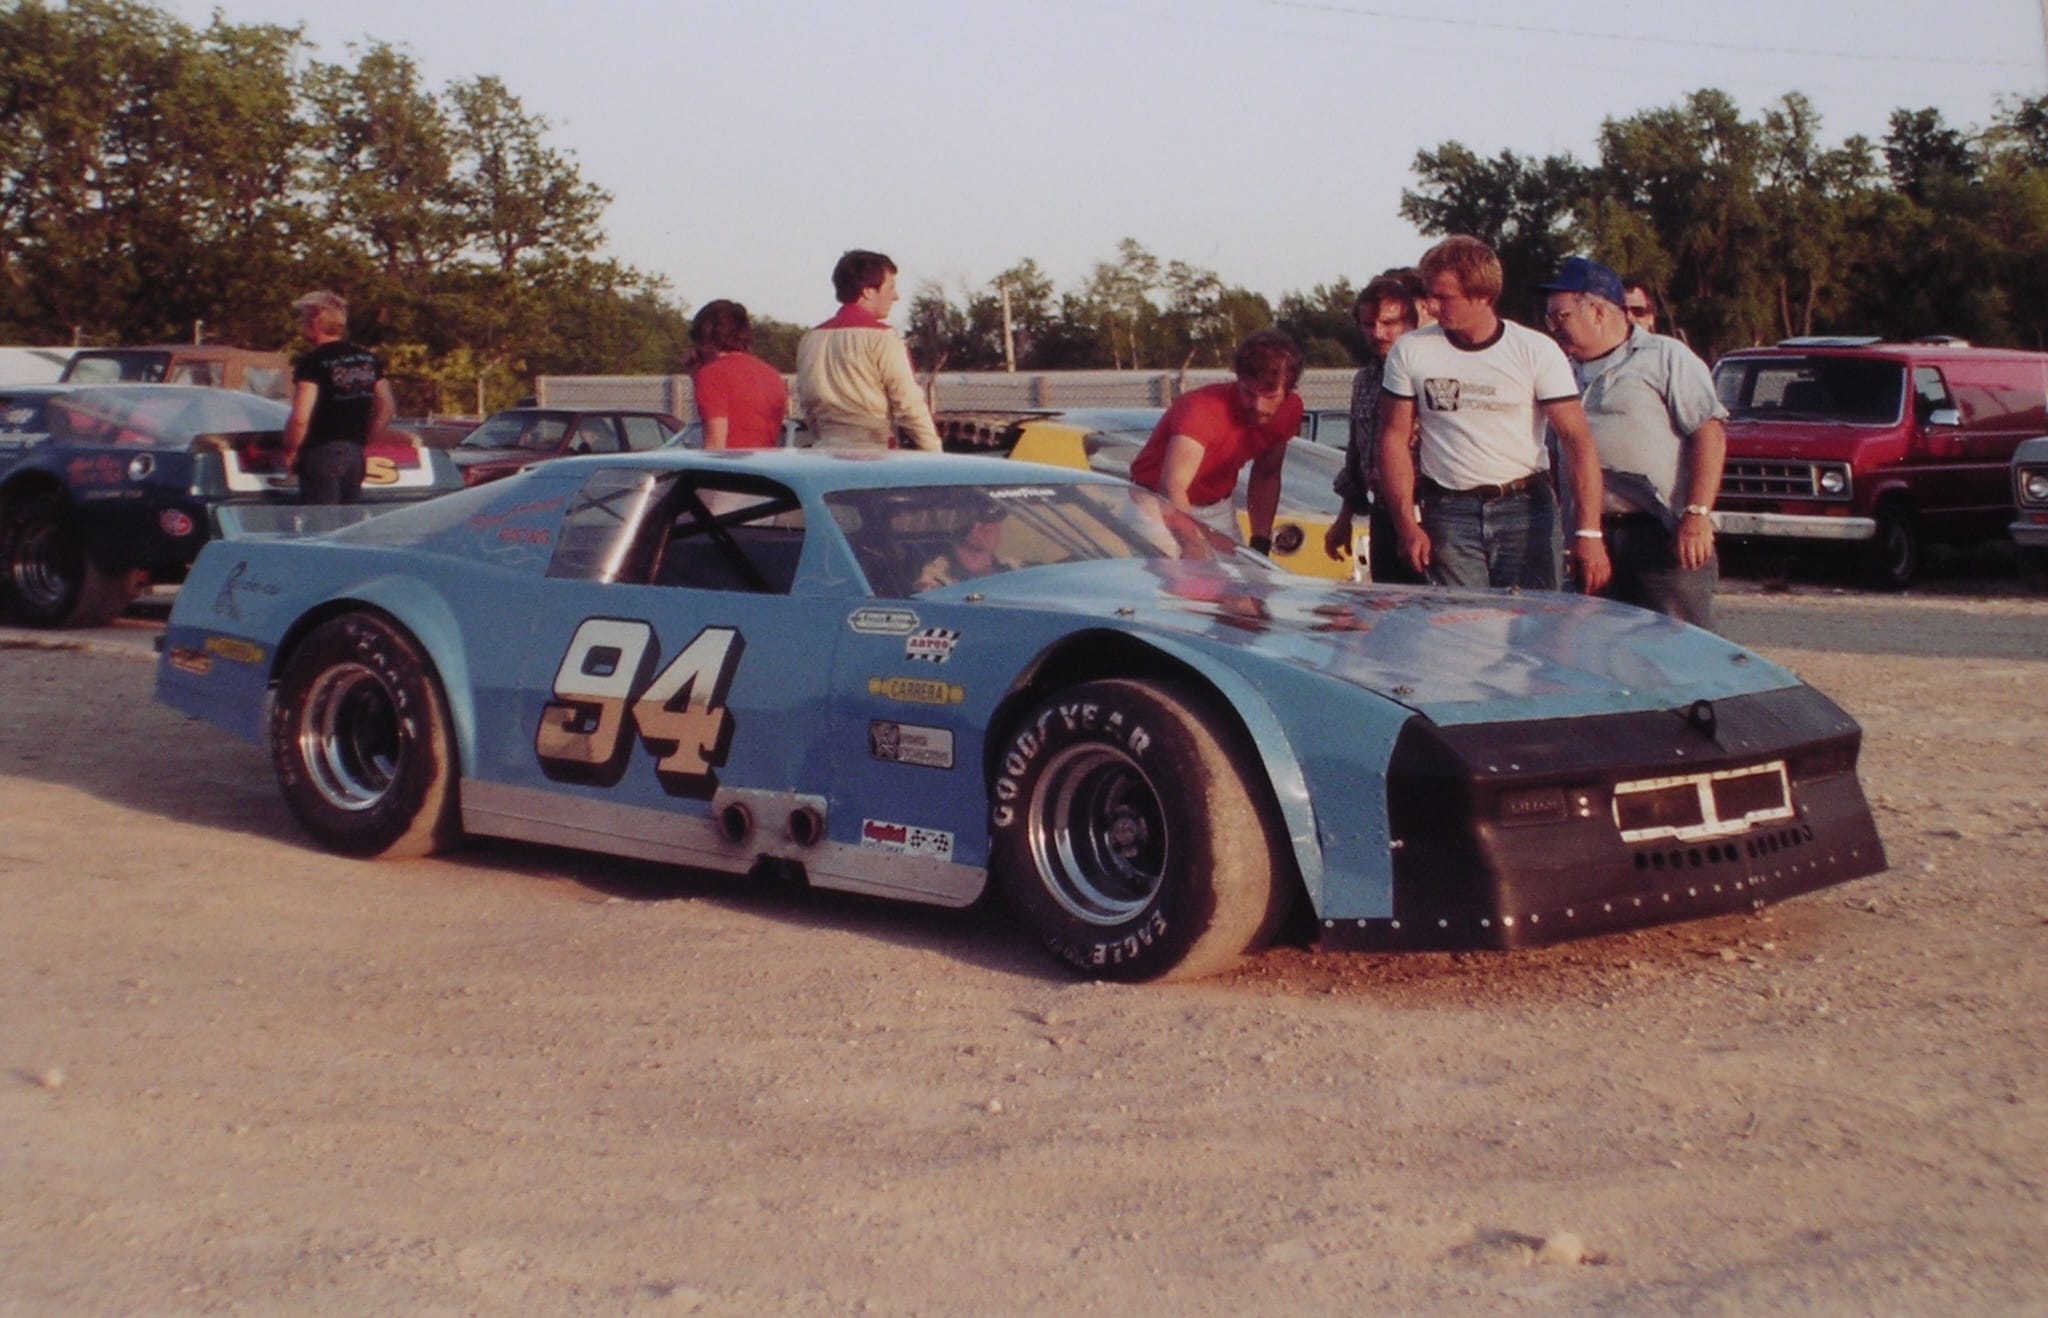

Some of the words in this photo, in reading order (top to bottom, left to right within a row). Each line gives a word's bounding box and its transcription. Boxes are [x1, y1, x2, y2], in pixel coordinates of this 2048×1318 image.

[535, 616, 741, 796] 94
[890, 680, 944, 701] CARRERA
[993, 703, 1151, 828] GOODYEAR
[1091, 908, 1168, 965] EAGLE
